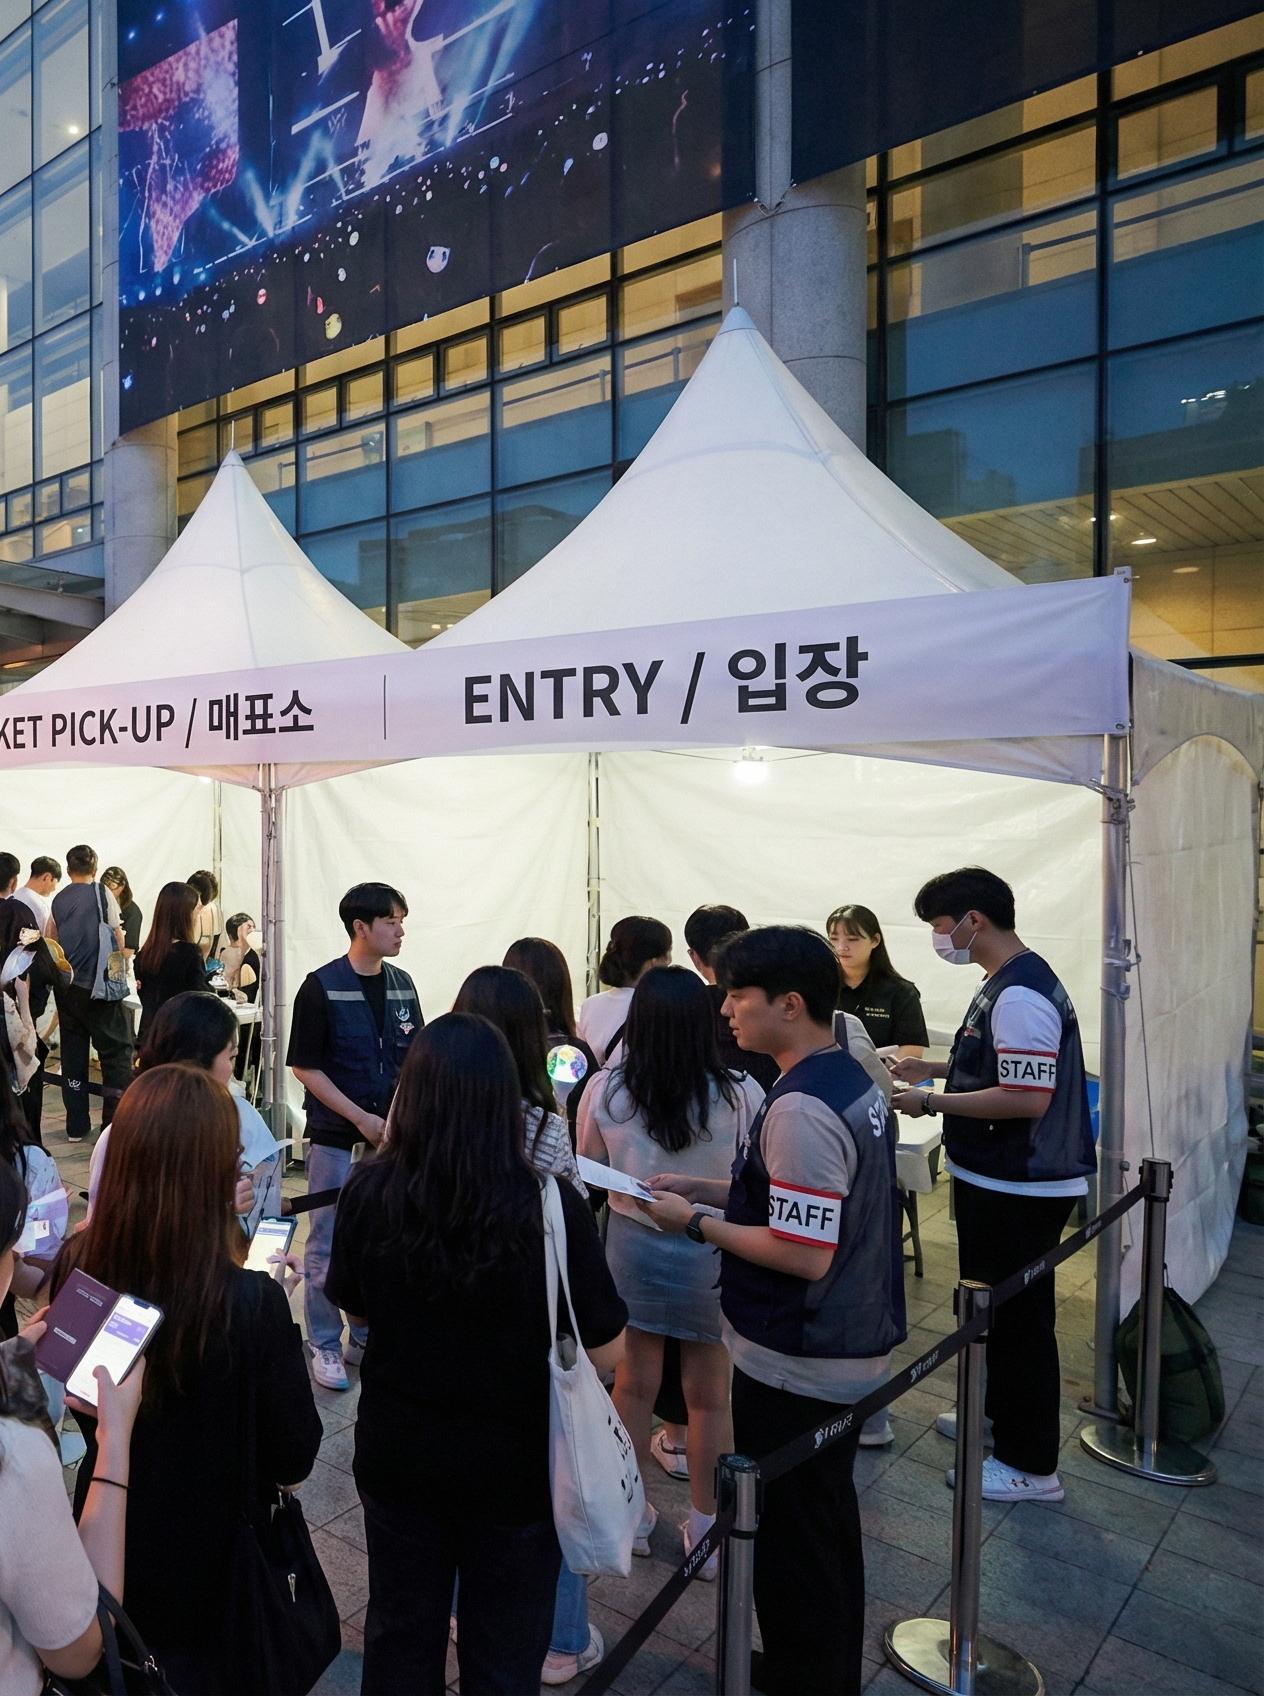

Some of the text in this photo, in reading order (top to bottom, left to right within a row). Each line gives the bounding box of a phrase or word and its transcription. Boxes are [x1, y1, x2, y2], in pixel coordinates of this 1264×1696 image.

[464, 636, 869, 725] ENTRY / 입장
[51, 704, 175, 748] PICK-UP
[184, 698, 197, 749] /
[208, 690, 315, 741] 매표소
[1000, 1059, 1056, 1082] STAFF
[769, 1194, 834, 1230] STAFF
